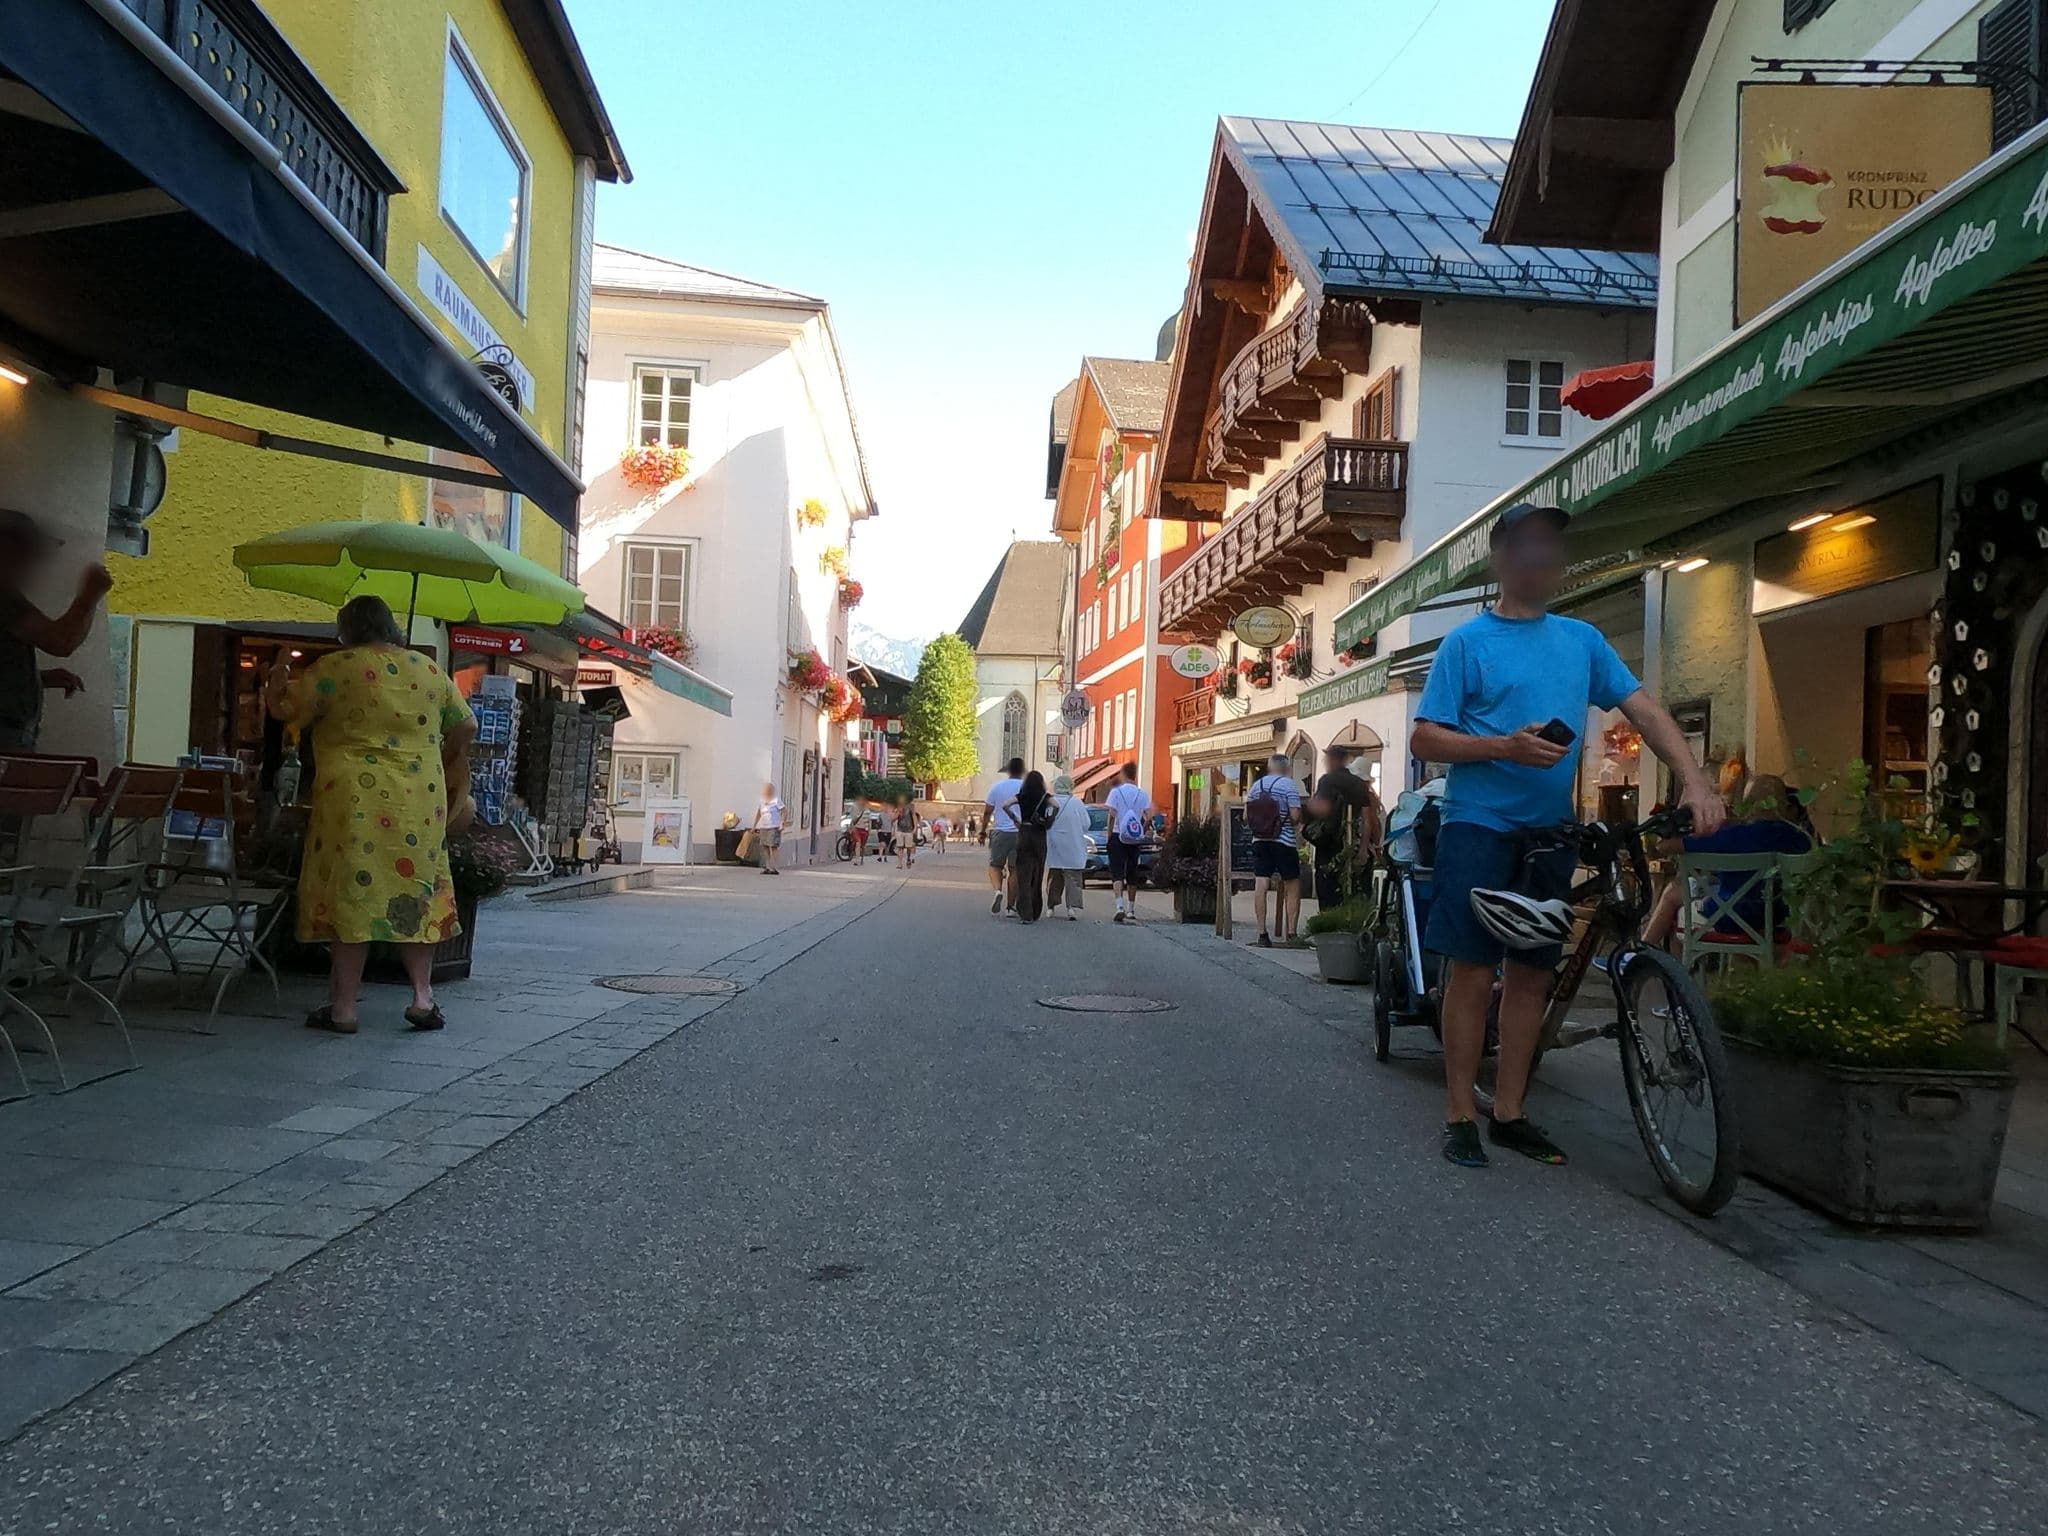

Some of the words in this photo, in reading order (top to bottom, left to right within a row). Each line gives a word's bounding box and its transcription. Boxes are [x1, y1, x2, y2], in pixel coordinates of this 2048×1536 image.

[1847, 171, 1928, 184] KRONPRINZ
[1571, 420, 1641, 504] NATÜRLICH
[1652, 353, 1765, 454] Apfelmarmelade
[1774, 293, 1874, 381] Apfelchips
[1893, 219, 1997, 308] Apfeltee
[455, 637, 502, 648] LOTTERIEN
[1180, 663, 1210, 672] ADEG
[577, 671, 610, 681] UTOMAT
